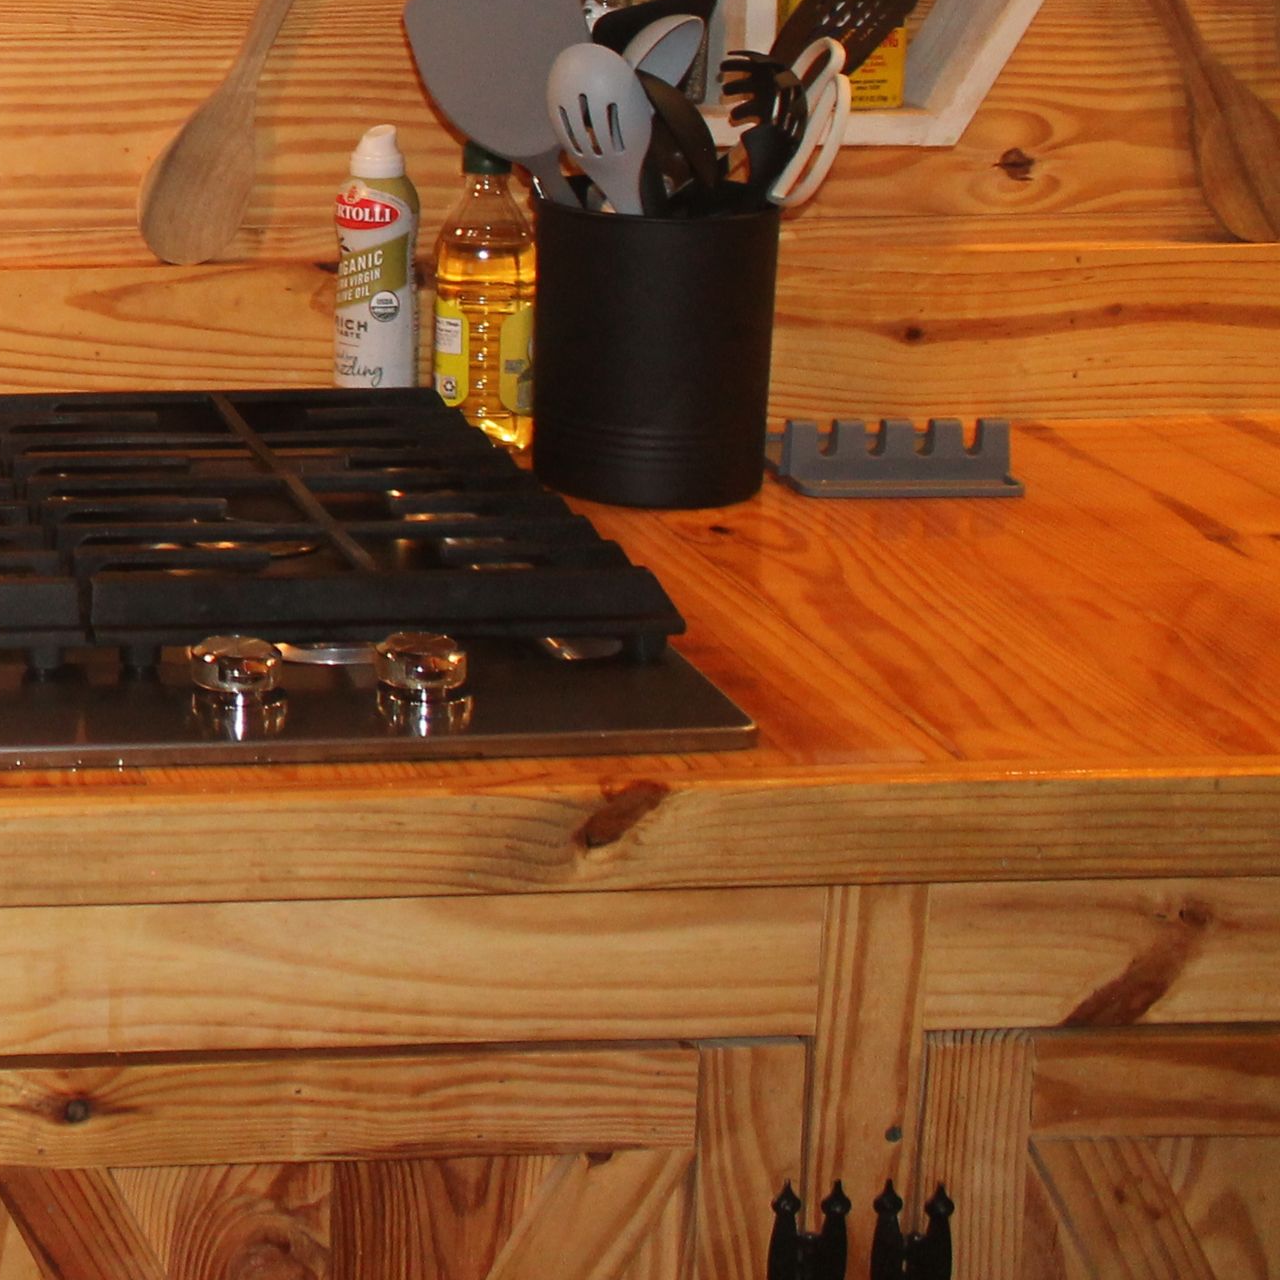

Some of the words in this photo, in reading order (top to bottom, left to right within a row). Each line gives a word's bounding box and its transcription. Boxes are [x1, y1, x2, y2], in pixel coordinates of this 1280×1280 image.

[336, 204, 391, 222] RTOLLI
[351, 268, 381, 287] VIRGIN
[355, 285, 370, 299] OIL
